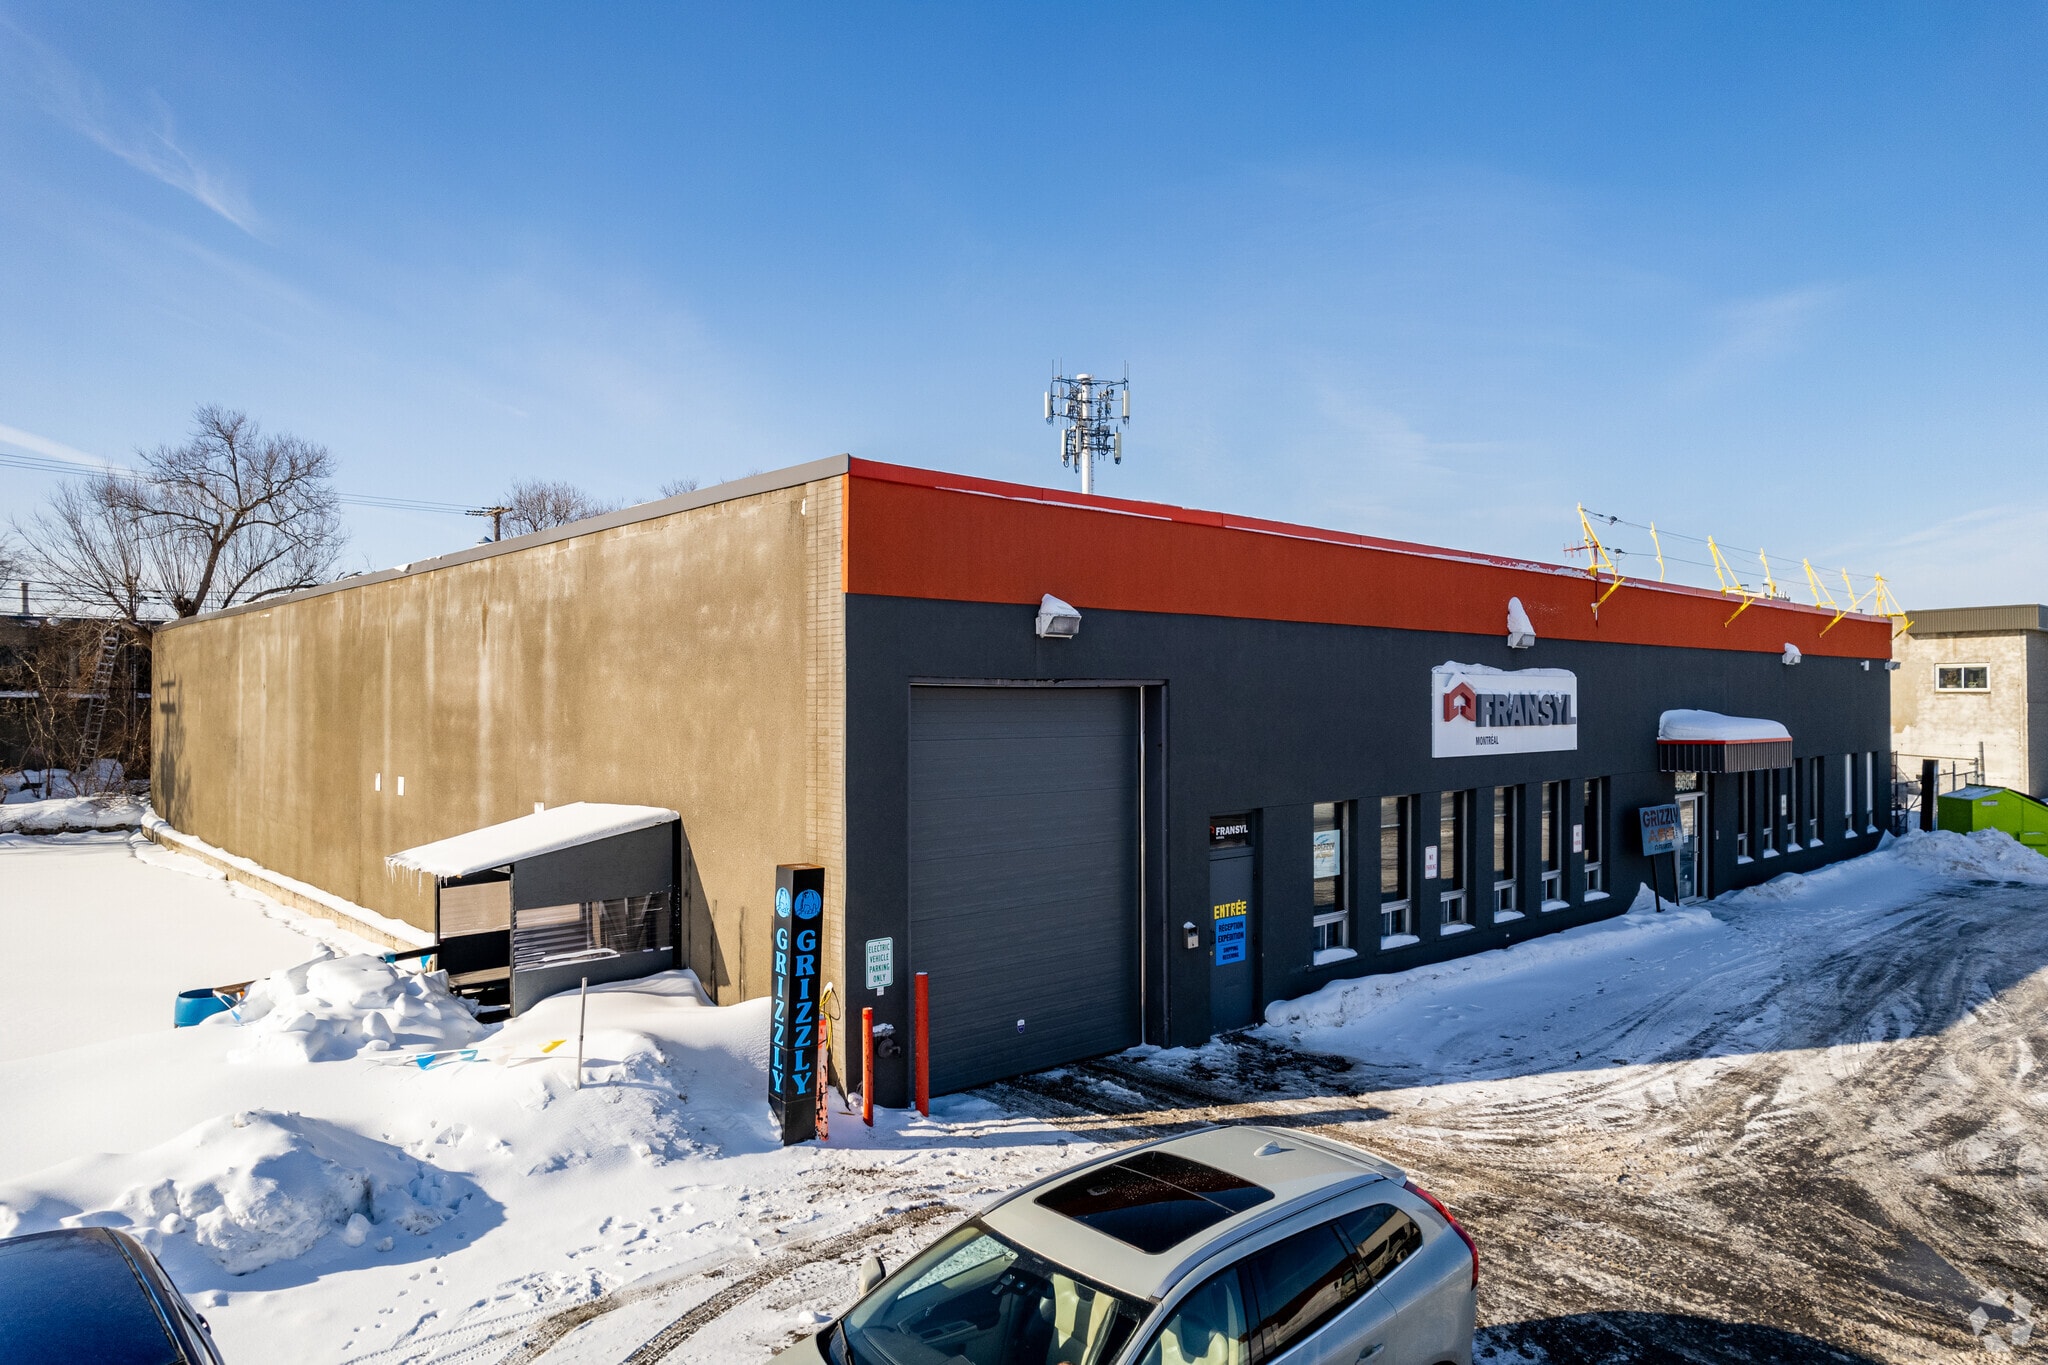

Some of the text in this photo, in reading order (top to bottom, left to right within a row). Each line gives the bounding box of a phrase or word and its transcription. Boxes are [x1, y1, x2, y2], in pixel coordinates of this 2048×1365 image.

[1476, 693, 1577, 728] FRANSYL
[1643, 807, 1679, 828] GRIZZLY
[1215, 824, 1249, 836] FRANSYL
[1213, 899, 1247, 920] ENTRÉE
[868, 943, 890, 953] ELECTRIC
[869, 953, 889, 963] VEHICLE
[869, 963, 890, 973] PARKING
[873, 974, 886, 983] ONLY
[772, 927, 788, 1094] GRIZZLY
[792, 929, 816, 1095] GRIZZLY
